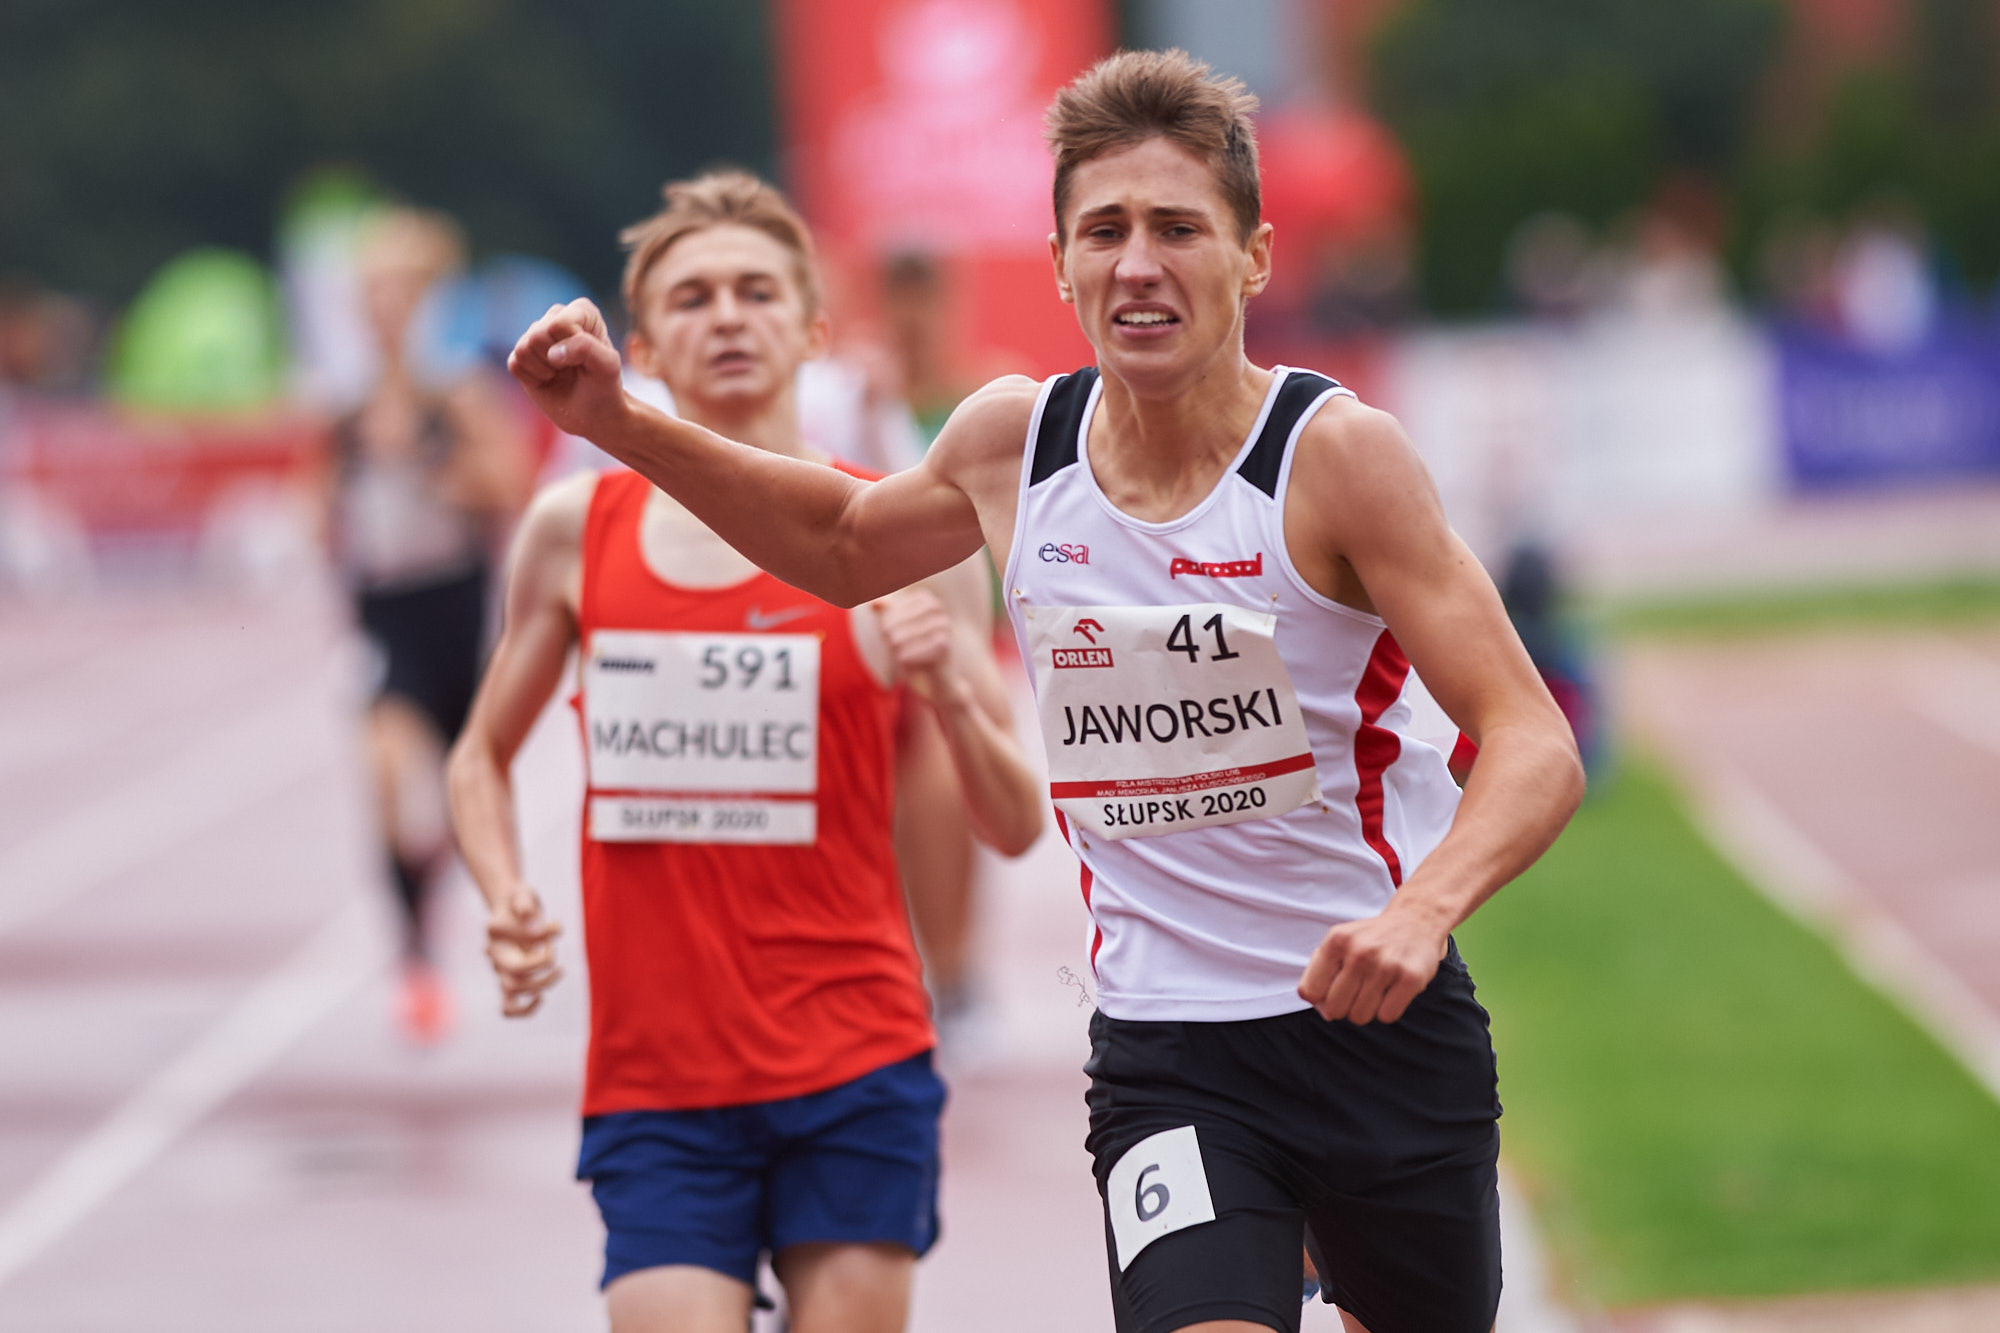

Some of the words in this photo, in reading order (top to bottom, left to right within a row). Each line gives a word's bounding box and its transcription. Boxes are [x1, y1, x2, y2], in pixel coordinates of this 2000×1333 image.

[1055, 650, 1110, 667] ORLEN
[1166, 613, 1240, 663] 41
[700, 645, 797, 690] 591
[1063, 688, 1282, 746] JAWORSKI
[594, 720, 810, 761] MACHULEC
[712, 808, 770, 830] 2020
[1104, 799, 1195, 826] SŁUPSK
[1201, 787, 1266, 816] 2020
[1135, 1163, 1170, 1222] 6
